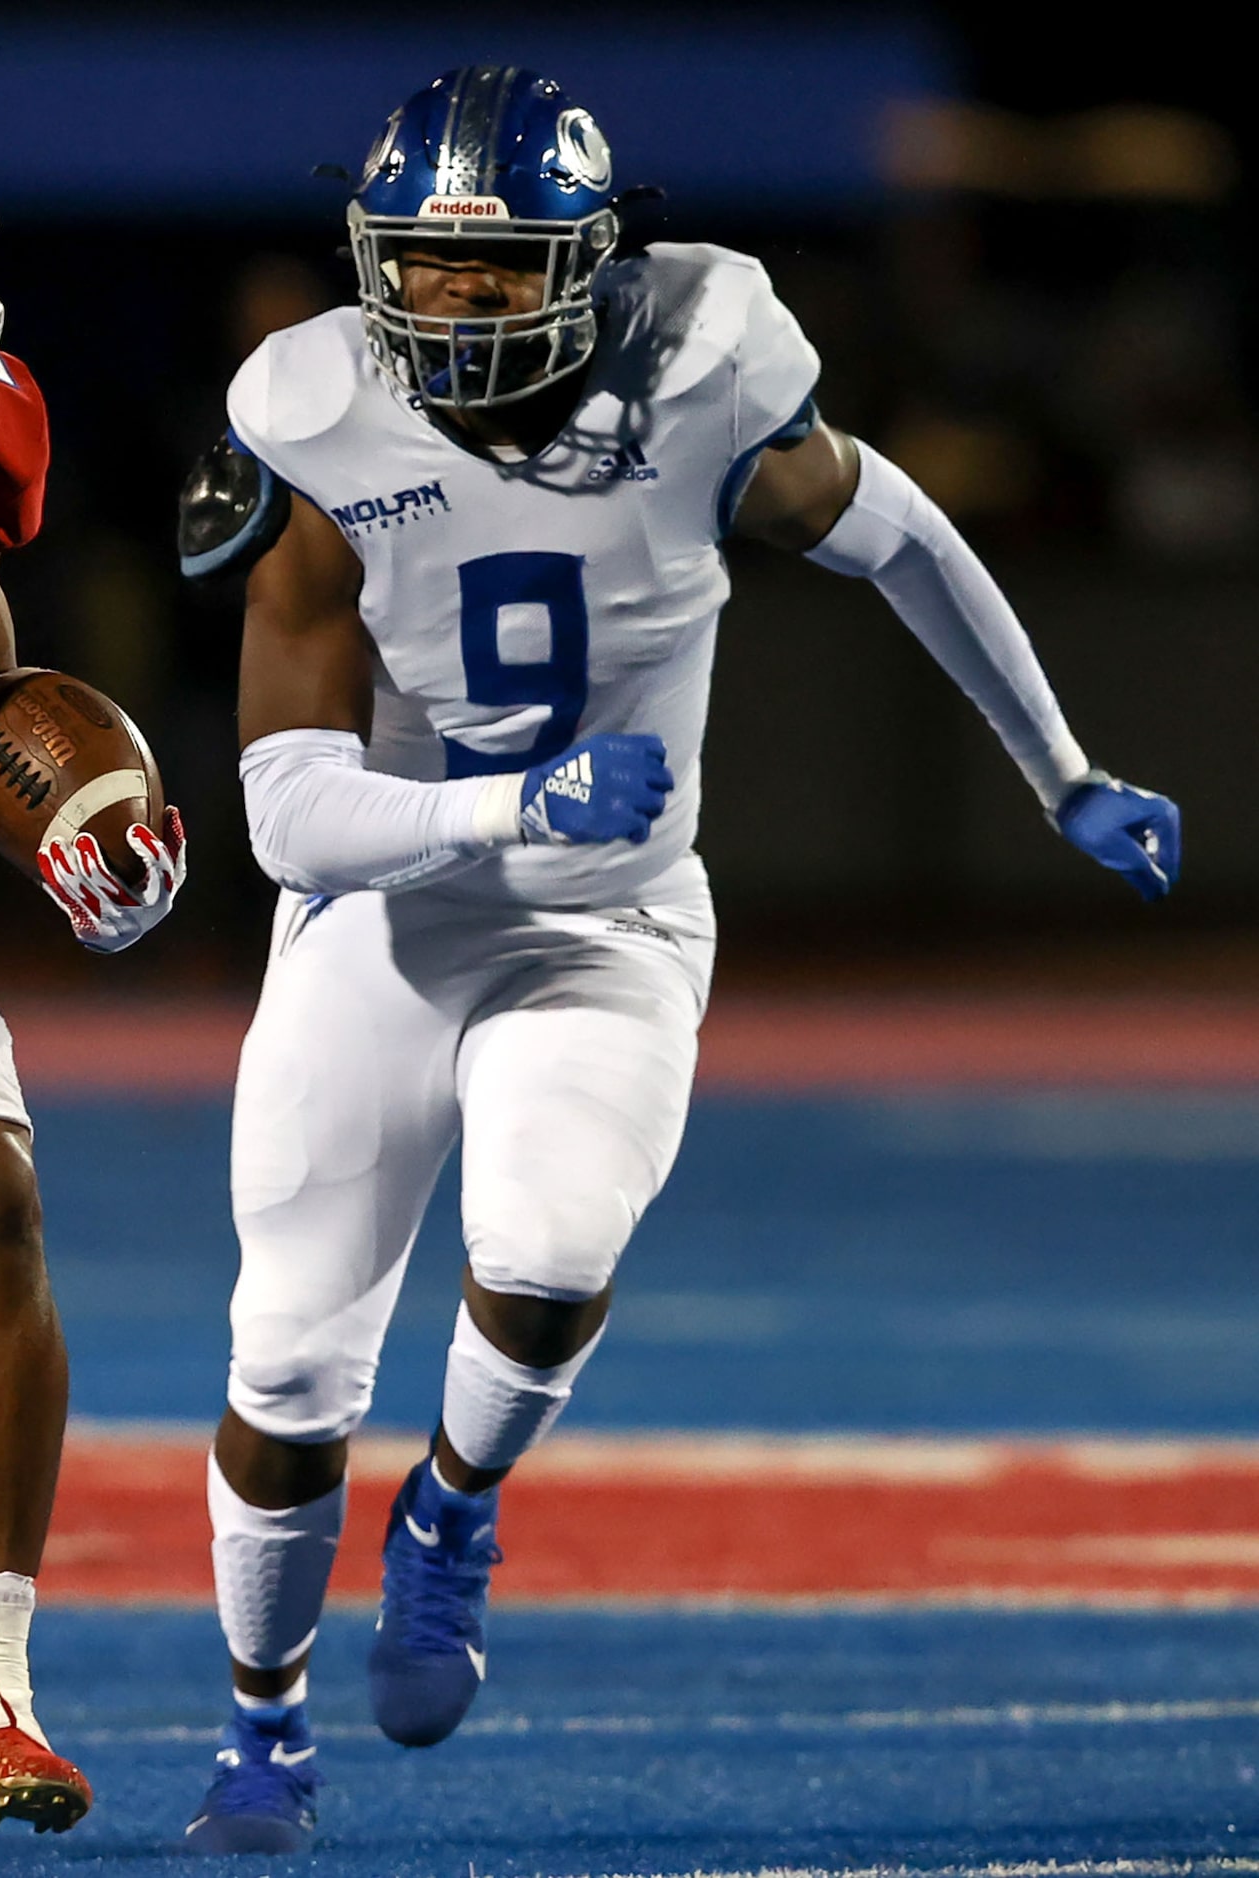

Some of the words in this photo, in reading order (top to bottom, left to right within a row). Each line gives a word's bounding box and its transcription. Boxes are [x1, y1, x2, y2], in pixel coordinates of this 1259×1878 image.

[428, 201, 498, 217] Riddell
[330, 479, 446, 528] NOLAN
[443, 551, 589, 780] 9
